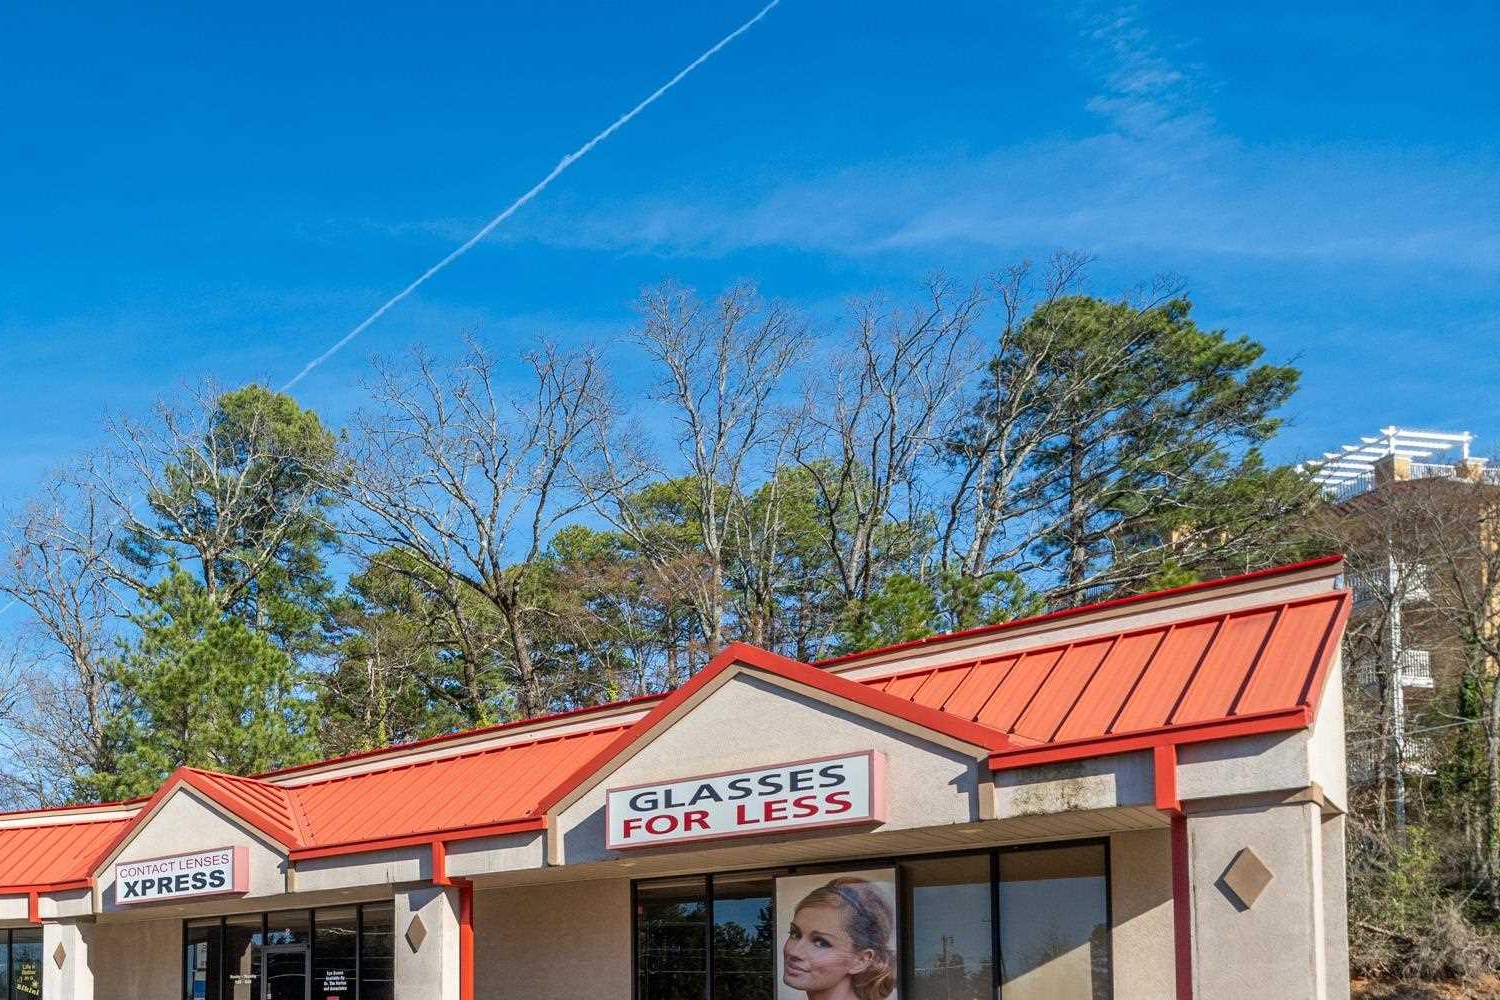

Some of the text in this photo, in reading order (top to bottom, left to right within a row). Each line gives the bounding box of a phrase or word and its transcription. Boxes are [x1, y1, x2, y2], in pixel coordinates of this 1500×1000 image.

[628, 765, 846, 813] GLASSES
[622, 791, 853, 839] FOR LESS
[119, 853, 230, 879] CONTACT LENSES
[123, 869, 226, 898] XPRESS
